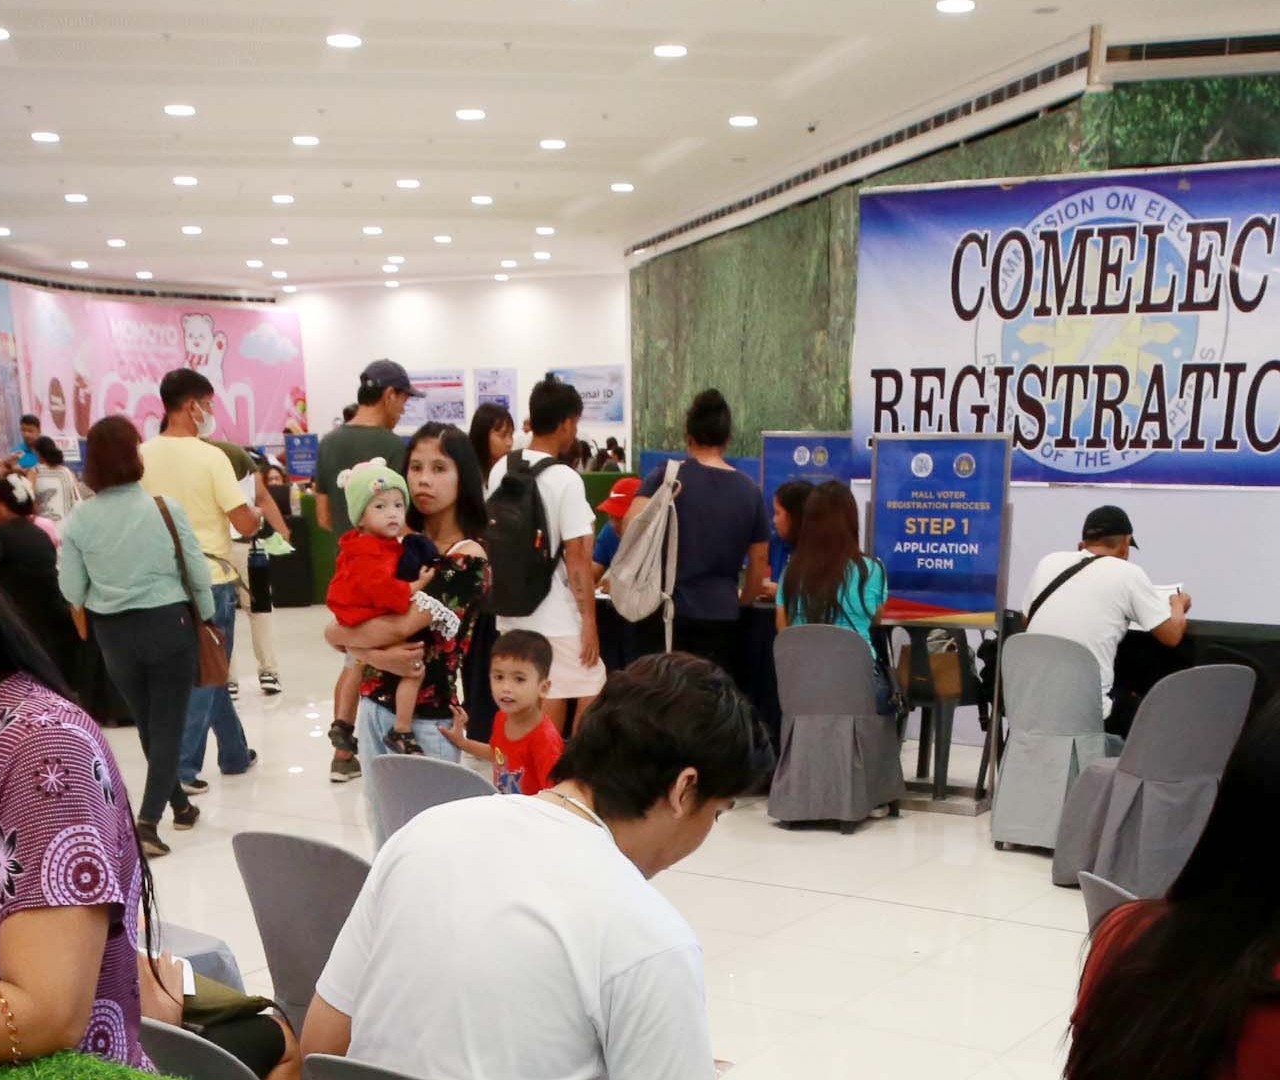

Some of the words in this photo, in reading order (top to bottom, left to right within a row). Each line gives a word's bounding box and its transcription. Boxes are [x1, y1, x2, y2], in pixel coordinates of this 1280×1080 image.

[1106, 192, 1136, 211] ON
[951, 216, 1277, 321] COMELEC
[1075, 450, 1111, 468] THE
[937, 490, 966, 499] VOTER
[886, 501, 949, 510] REGISTRATION
[950, 501, 991, 511] PROCESS
[905, 517, 956, 535] STEP
[961, 517, 969, 535] 1
[894, 541, 979, 554] APPLICATION
[917, 558, 954, 570] FORM
